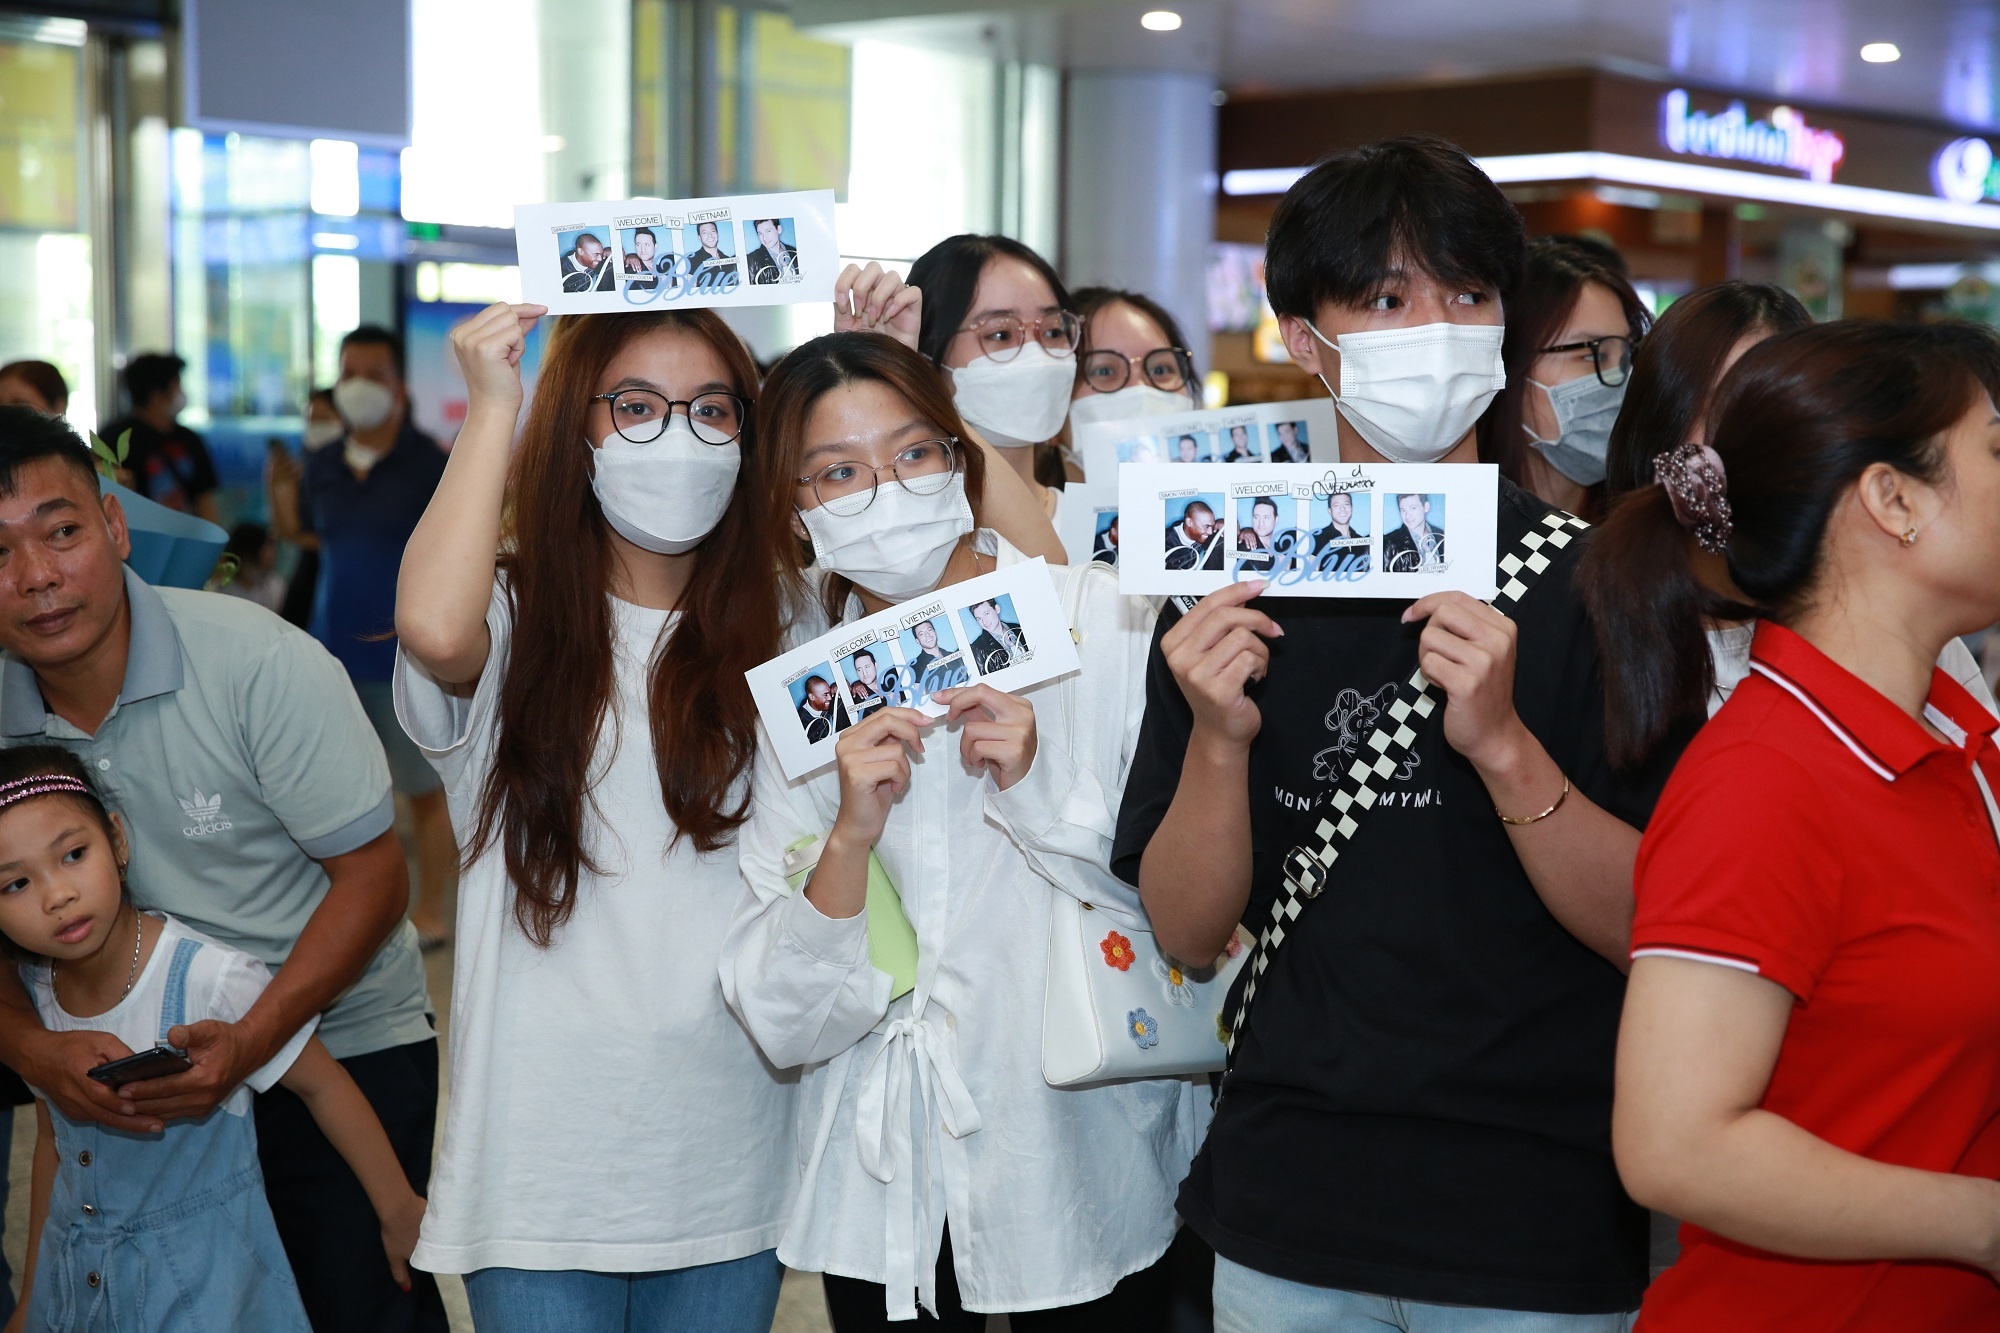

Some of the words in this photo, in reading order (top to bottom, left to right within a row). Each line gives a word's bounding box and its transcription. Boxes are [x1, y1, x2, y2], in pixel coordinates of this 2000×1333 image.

[616, 217, 660, 227] WELCOME
[669, 219, 681, 228] TO
[691, 210, 729, 221] VIETNAM
[623, 251, 743, 306] Blue
[1160, 491, 1177, 499] SIMON
[1234, 483, 1285, 495] WELCOME
[1296, 487, 1310, 497] TO
[1331, 539, 1353, 547] DUNCAN
[1228, 551, 1248, 559] ANTONY
[1232, 527, 1374, 586] Blue
[833, 633, 874, 659] WELCOME
[883, 628, 896, 638] TO
[904, 603, 943, 626] VIETNAM
[928, 659, 947, 670] DUNCAN
[865, 698, 881, 707] COSTA
[182, 820, 233, 837] adidas
